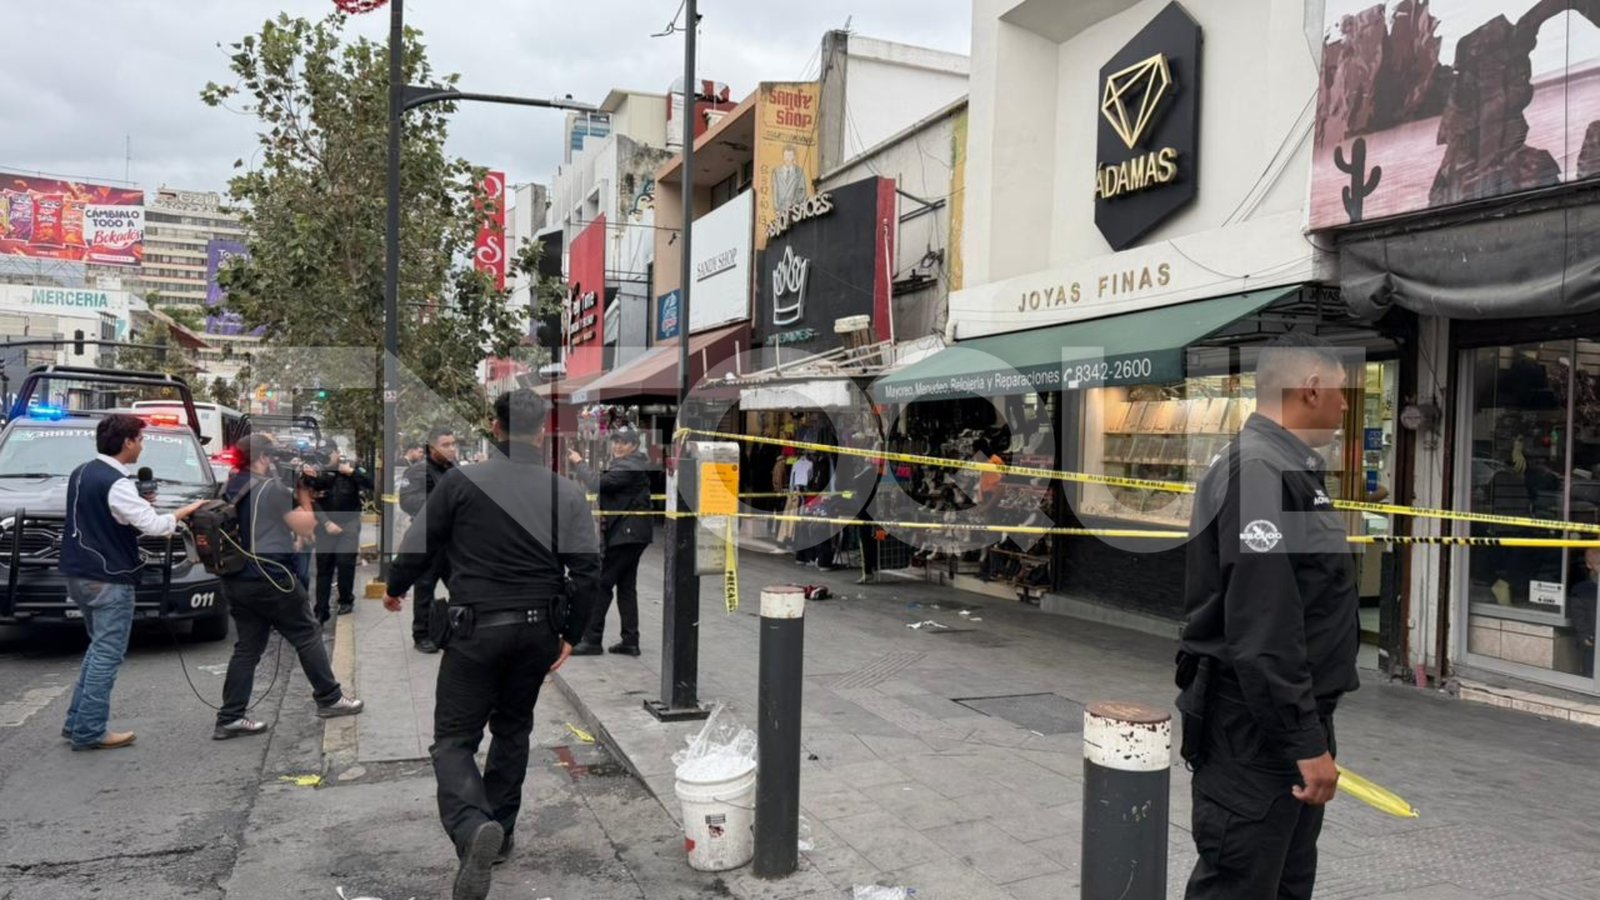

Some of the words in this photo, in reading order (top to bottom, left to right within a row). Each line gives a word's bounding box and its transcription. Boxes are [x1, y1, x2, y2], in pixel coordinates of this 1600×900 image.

[127, 219, 135, 227] A
[1018, 282, 1081, 312] JOYAS
[1098, 263, 1171, 297] FINAS
[1309, 288, 1340, 301] JYAS
[31, 288, 108, 308] MERCERIA
[987, 378, 993, 392] y
[995, 371, 1060, 390] Reparaciones
[1075, 358, 1152, 383] 8342-2600
[190, 592, 215, 608] 011
